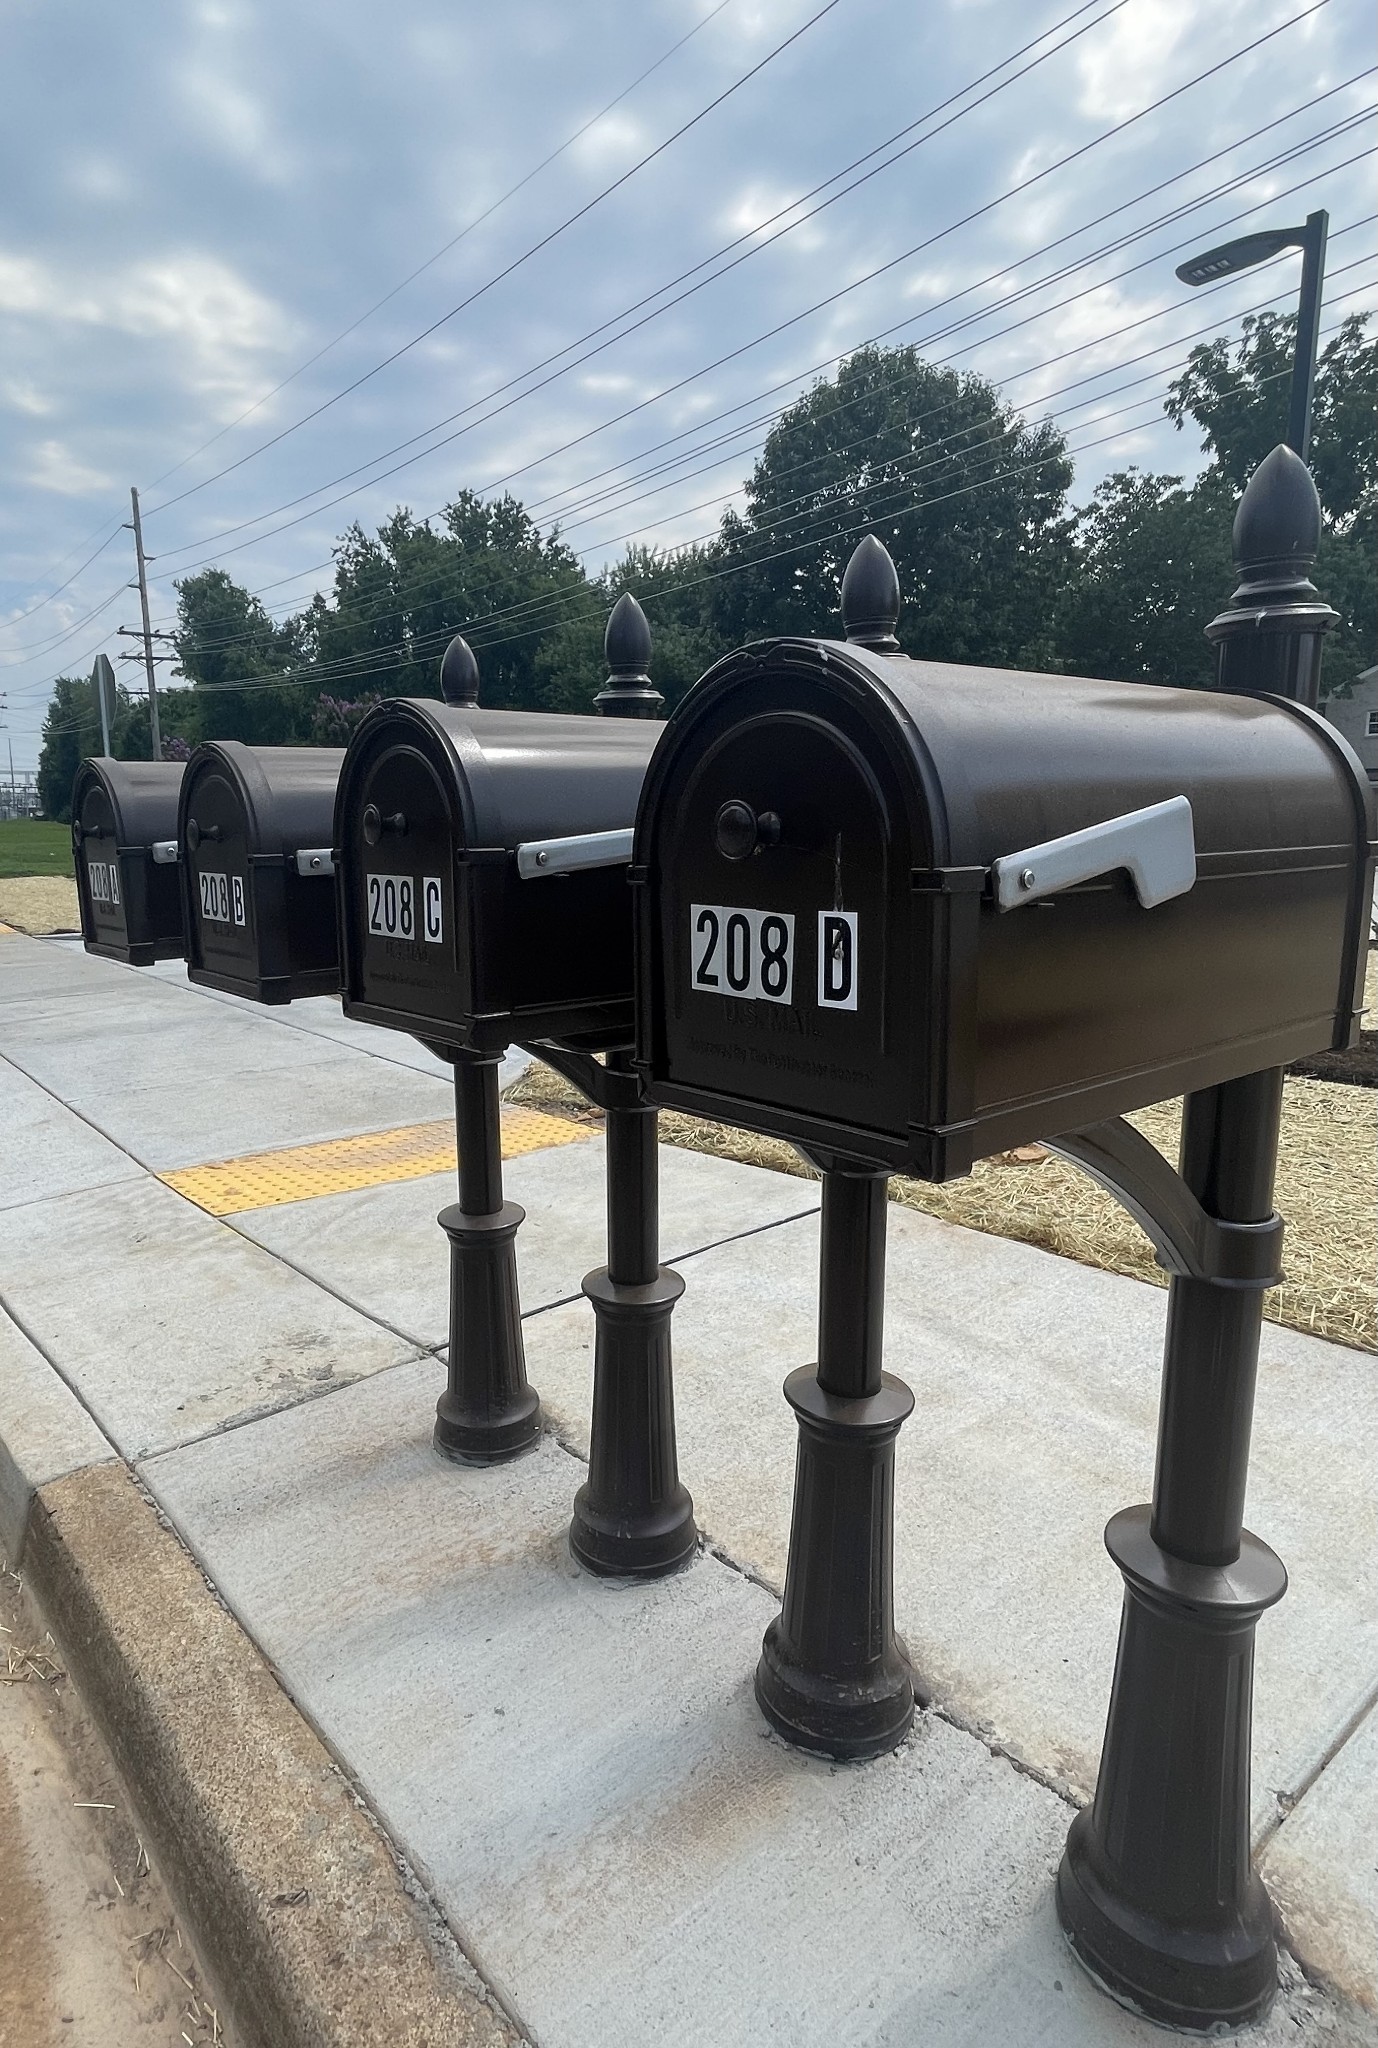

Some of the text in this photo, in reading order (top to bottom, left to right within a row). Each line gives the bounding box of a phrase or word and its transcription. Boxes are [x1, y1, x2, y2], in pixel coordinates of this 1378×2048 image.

[90, 864, 119, 902] 208 A
[202, 874, 243, 922] 208 B
[370, 877, 440, 938] 208 C
[696, 909, 852, 1002] 208 D
